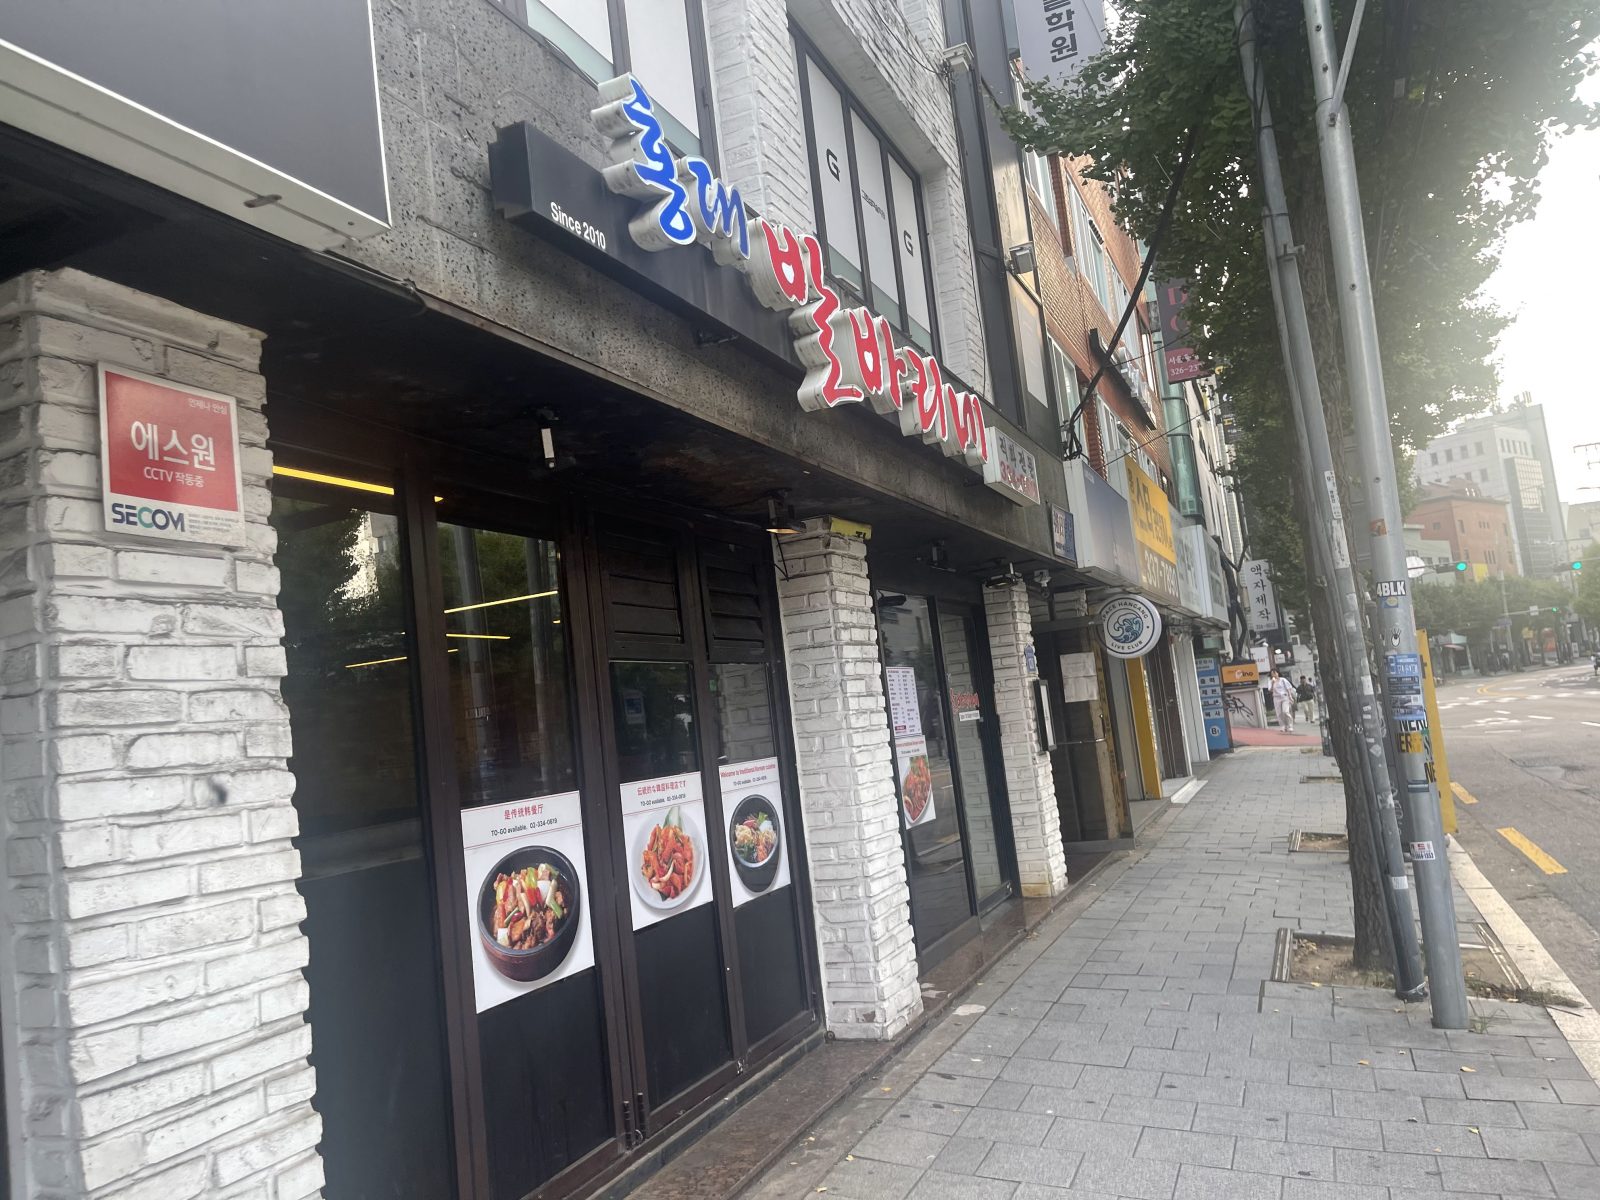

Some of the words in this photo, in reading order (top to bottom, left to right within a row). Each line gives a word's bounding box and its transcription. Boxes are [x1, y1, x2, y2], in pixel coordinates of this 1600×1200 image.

[1043, 0, 1078, 62] 학원
[826, 148, 841, 182] G
[551, 201, 582, 235] Since
[583, 221, 606, 250] 2010
[903, 230, 914, 257] G
[130, 420, 216, 472] 에스원
[144, 466, 174, 483] CCTV
[175, 471, 206, 488] 작동중
[111, 502, 186, 533] SECOM
[1376, 581, 1406, 597] 4BLK
[1111, 642, 1125, 650] LIVE
[1127, 640, 1143, 650] CLUB
[491, 827, 507, 837] TO-GO
